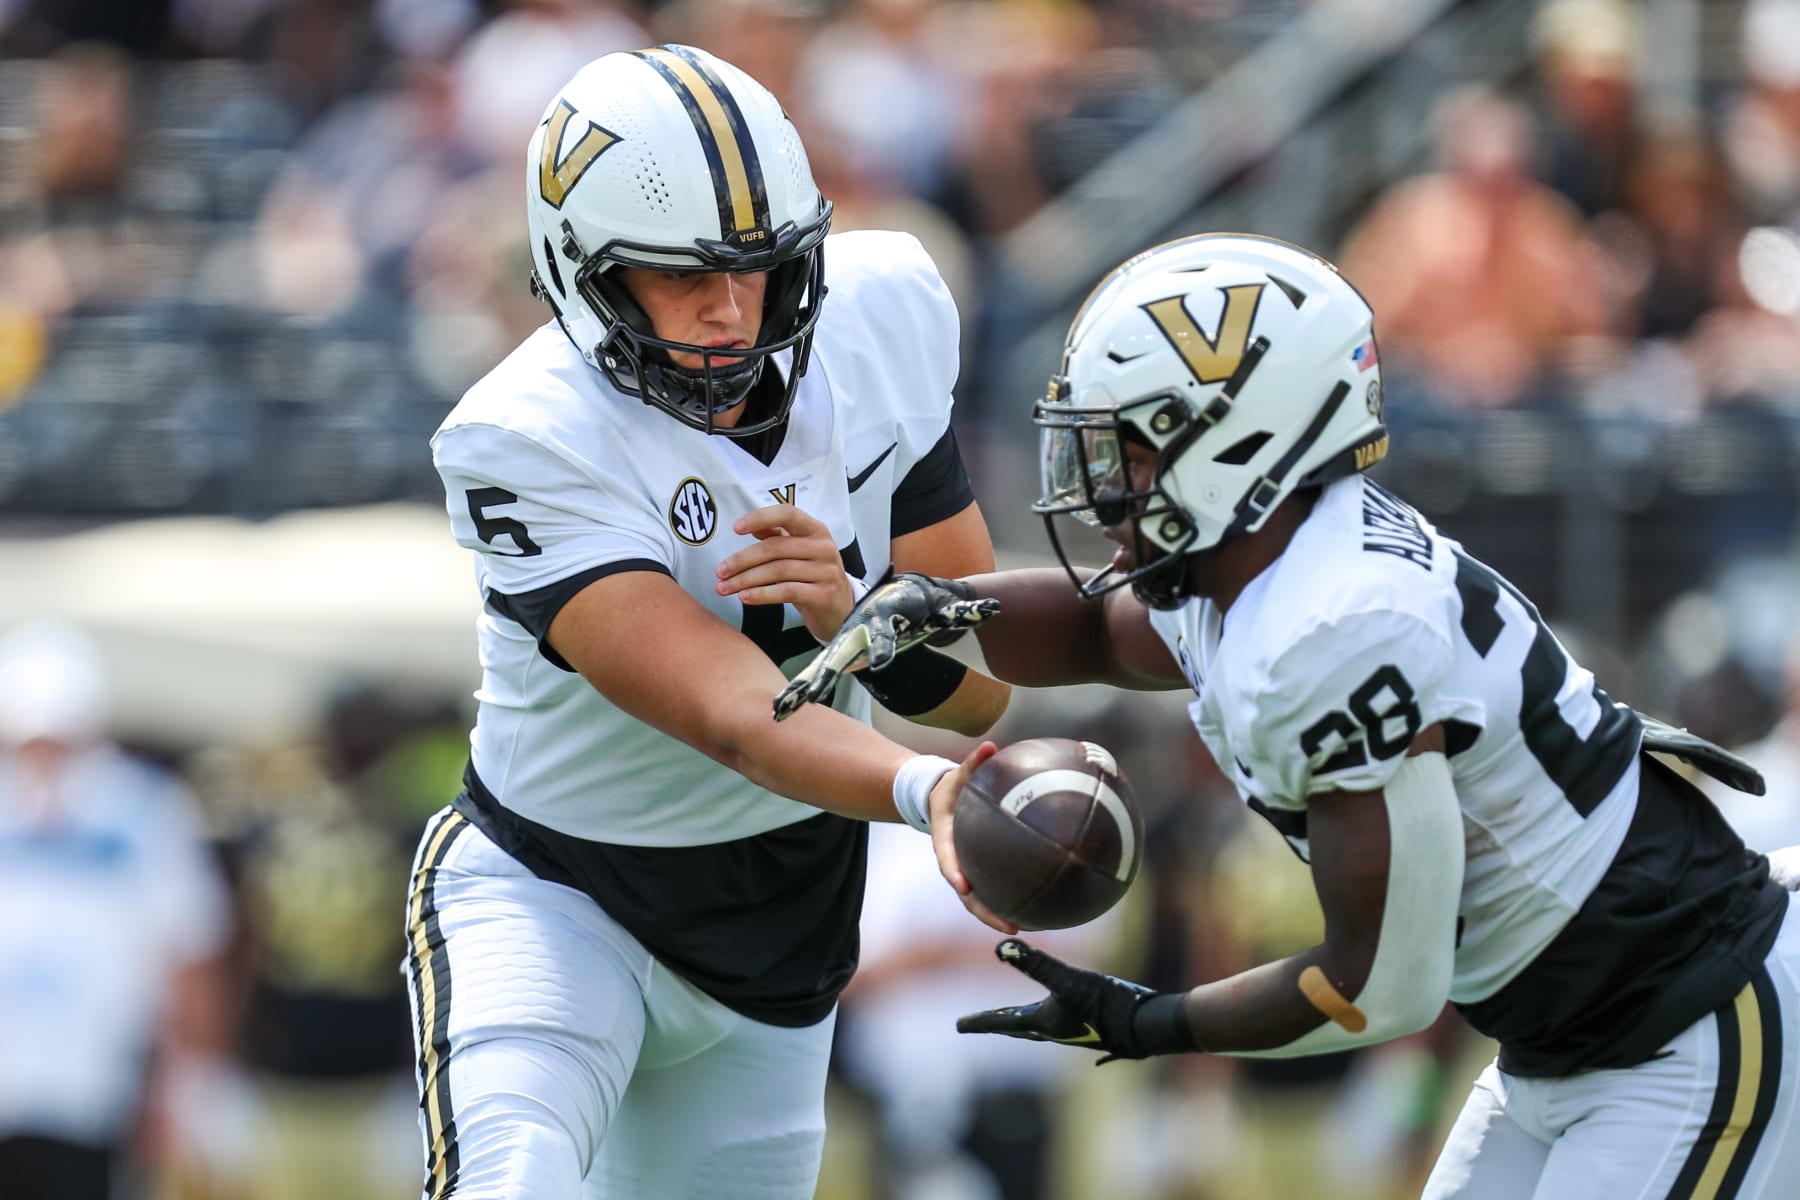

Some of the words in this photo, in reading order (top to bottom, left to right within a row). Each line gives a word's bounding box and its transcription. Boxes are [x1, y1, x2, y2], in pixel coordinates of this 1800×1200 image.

[540, 97, 625, 211] V
[739, 230, 765, 243] VUFB
[1138, 283, 1268, 385] V
[465, 486, 542, 557] 5
[673, 481, 715, 541] SEC
[1300, 663, 1422, 777] 28
